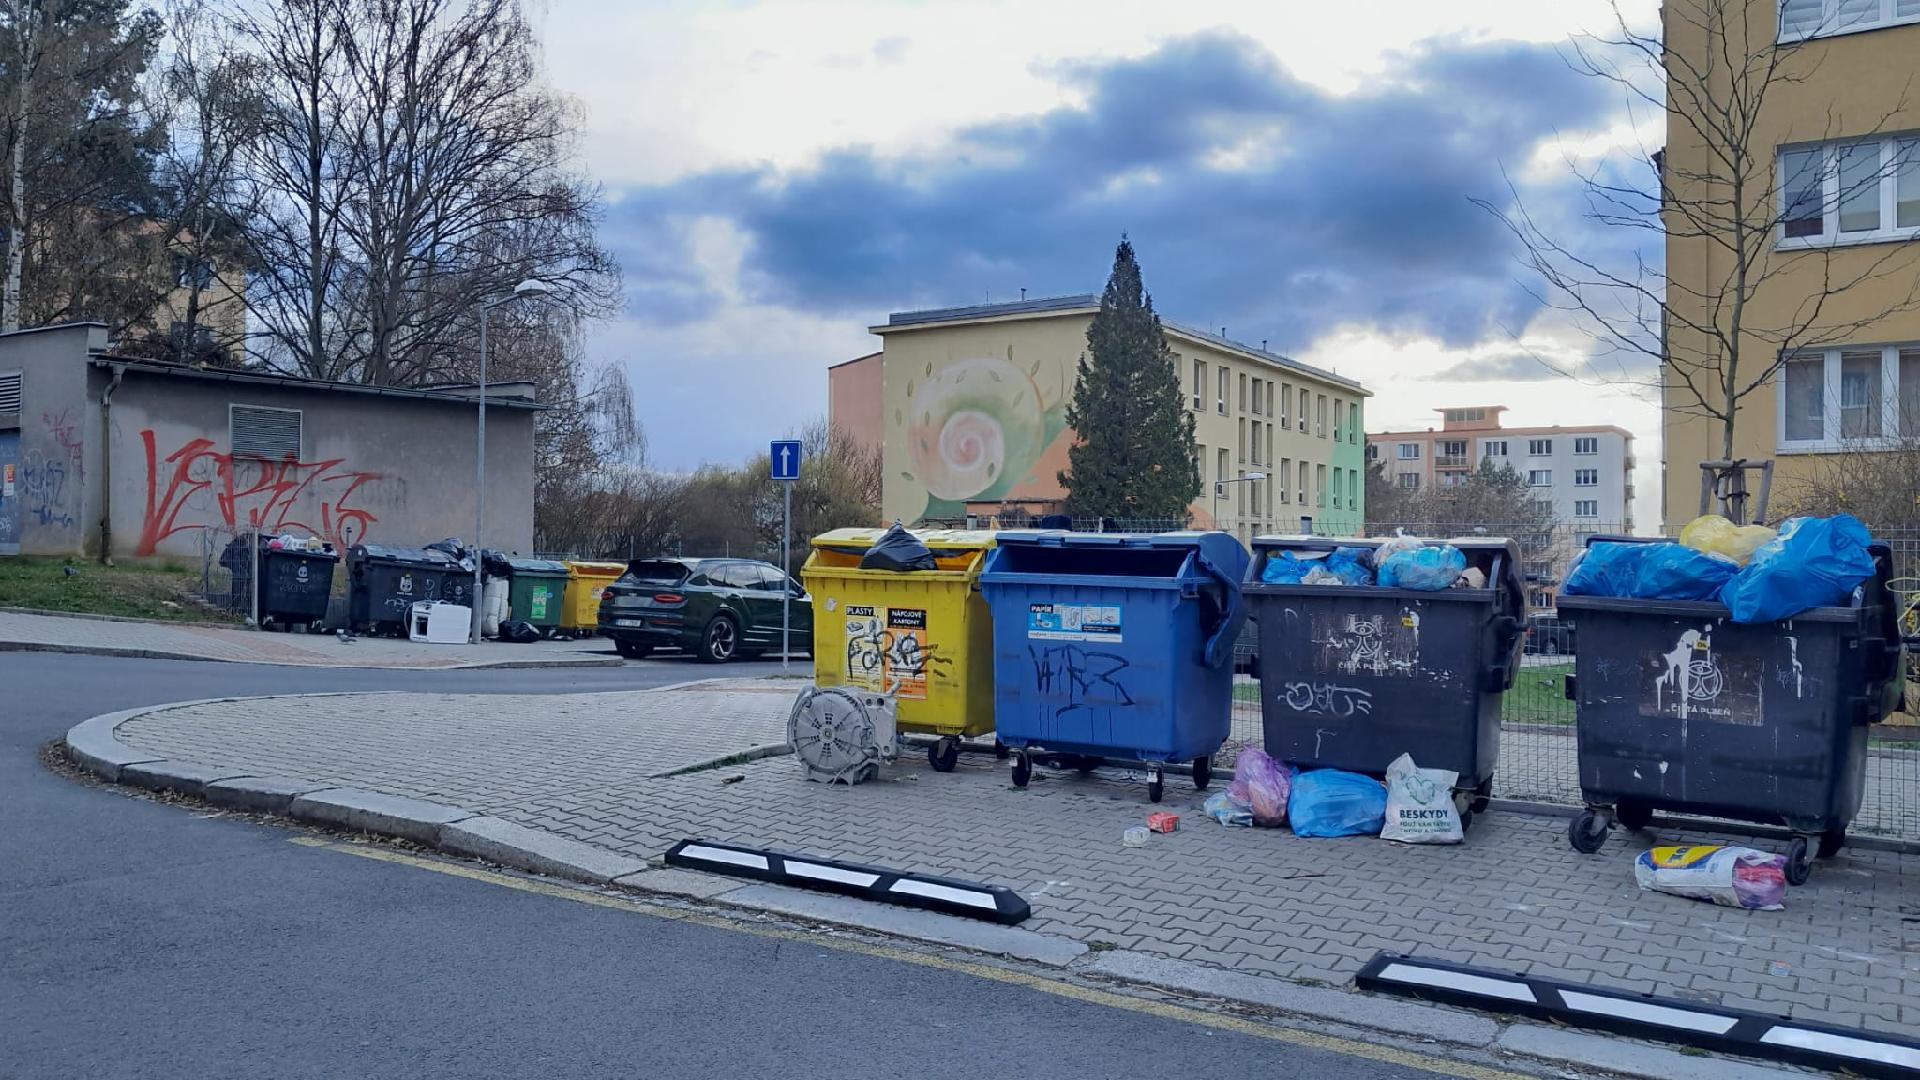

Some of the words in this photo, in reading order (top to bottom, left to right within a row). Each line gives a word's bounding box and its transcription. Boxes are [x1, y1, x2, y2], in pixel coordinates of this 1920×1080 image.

[846, 606, 873, 615] PLASTY
[893, 618, 920, 626] KARTONY
[1400, 809, 1448, 819] BESKYDY
